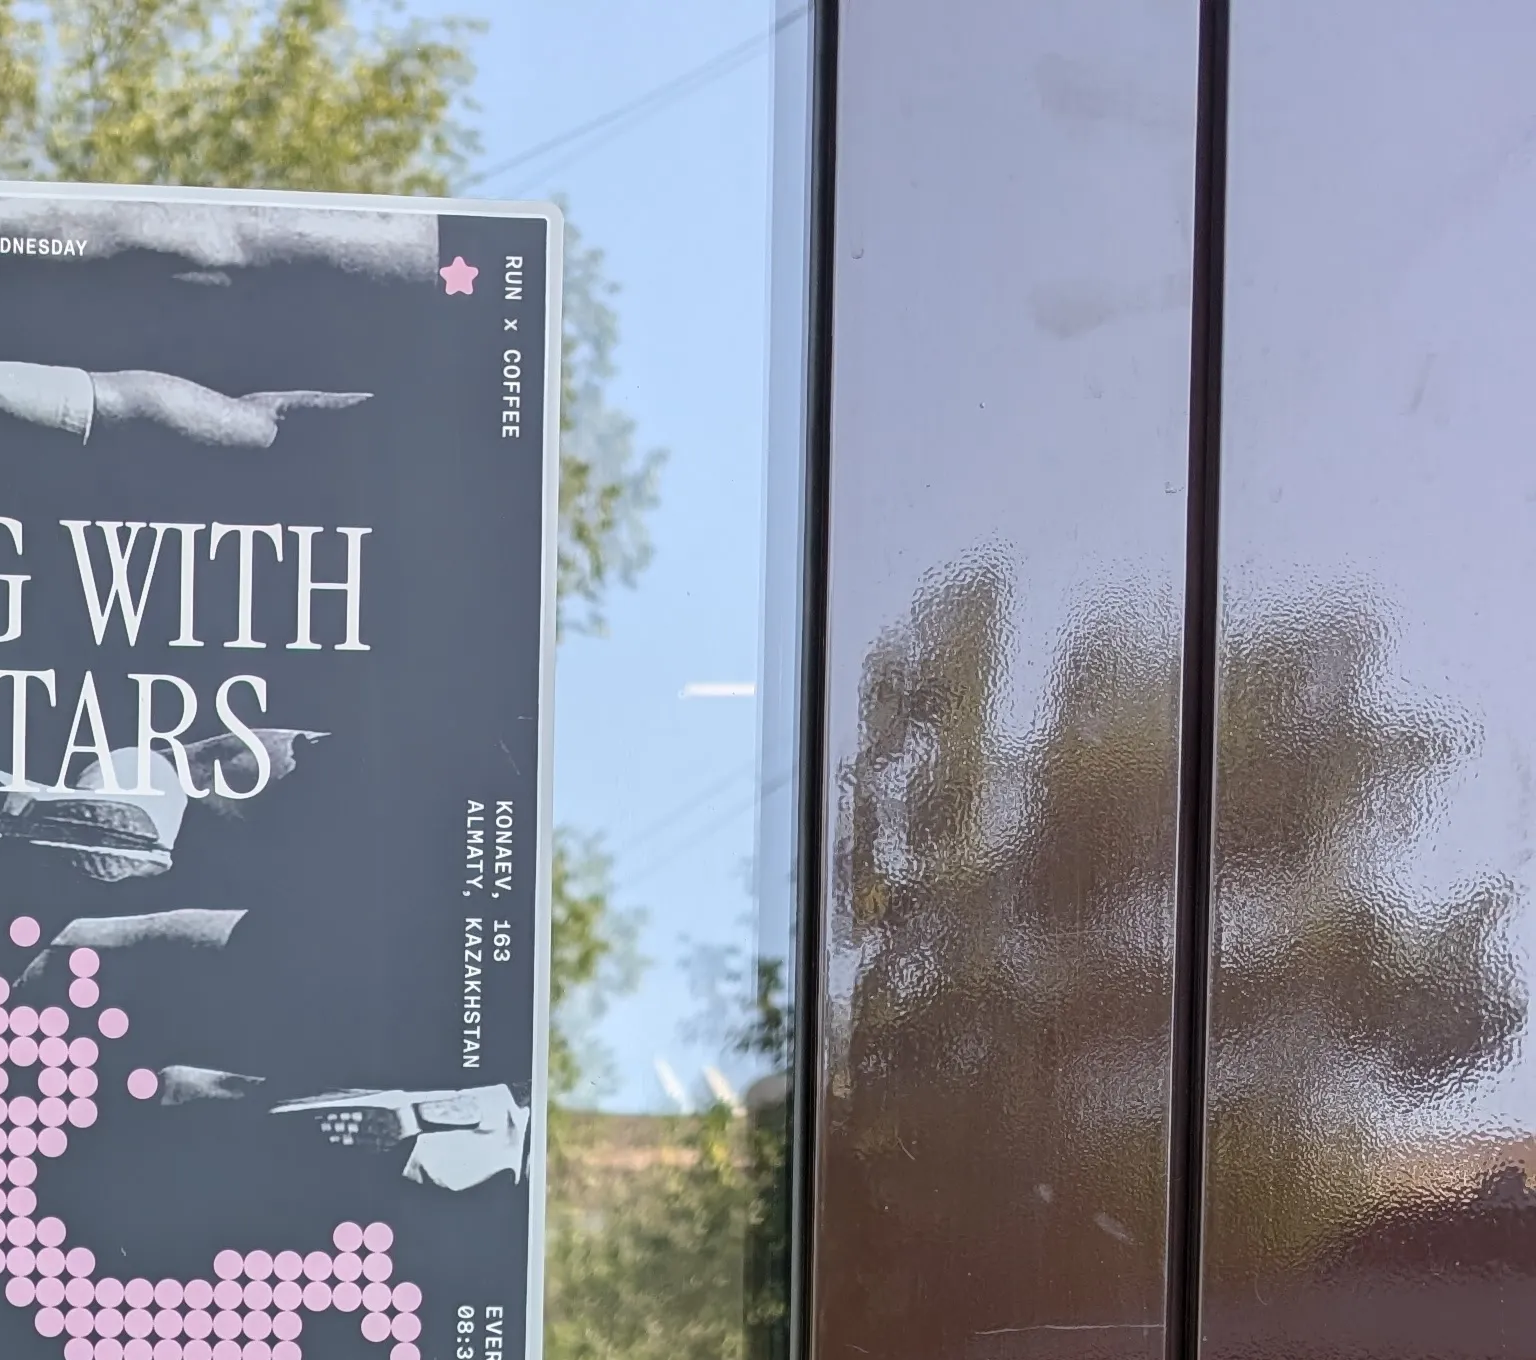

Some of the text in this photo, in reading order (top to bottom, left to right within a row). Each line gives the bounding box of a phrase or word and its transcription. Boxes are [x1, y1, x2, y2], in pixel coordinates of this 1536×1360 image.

[501, 255, 523, 439] RUN x COFFEE
[59, 519, 373, 650] WITH
[462, 799, 484, 1068] ALMATY, KAZAKHSTAN
[492, 800, 513, 962] KONAEV, 163
